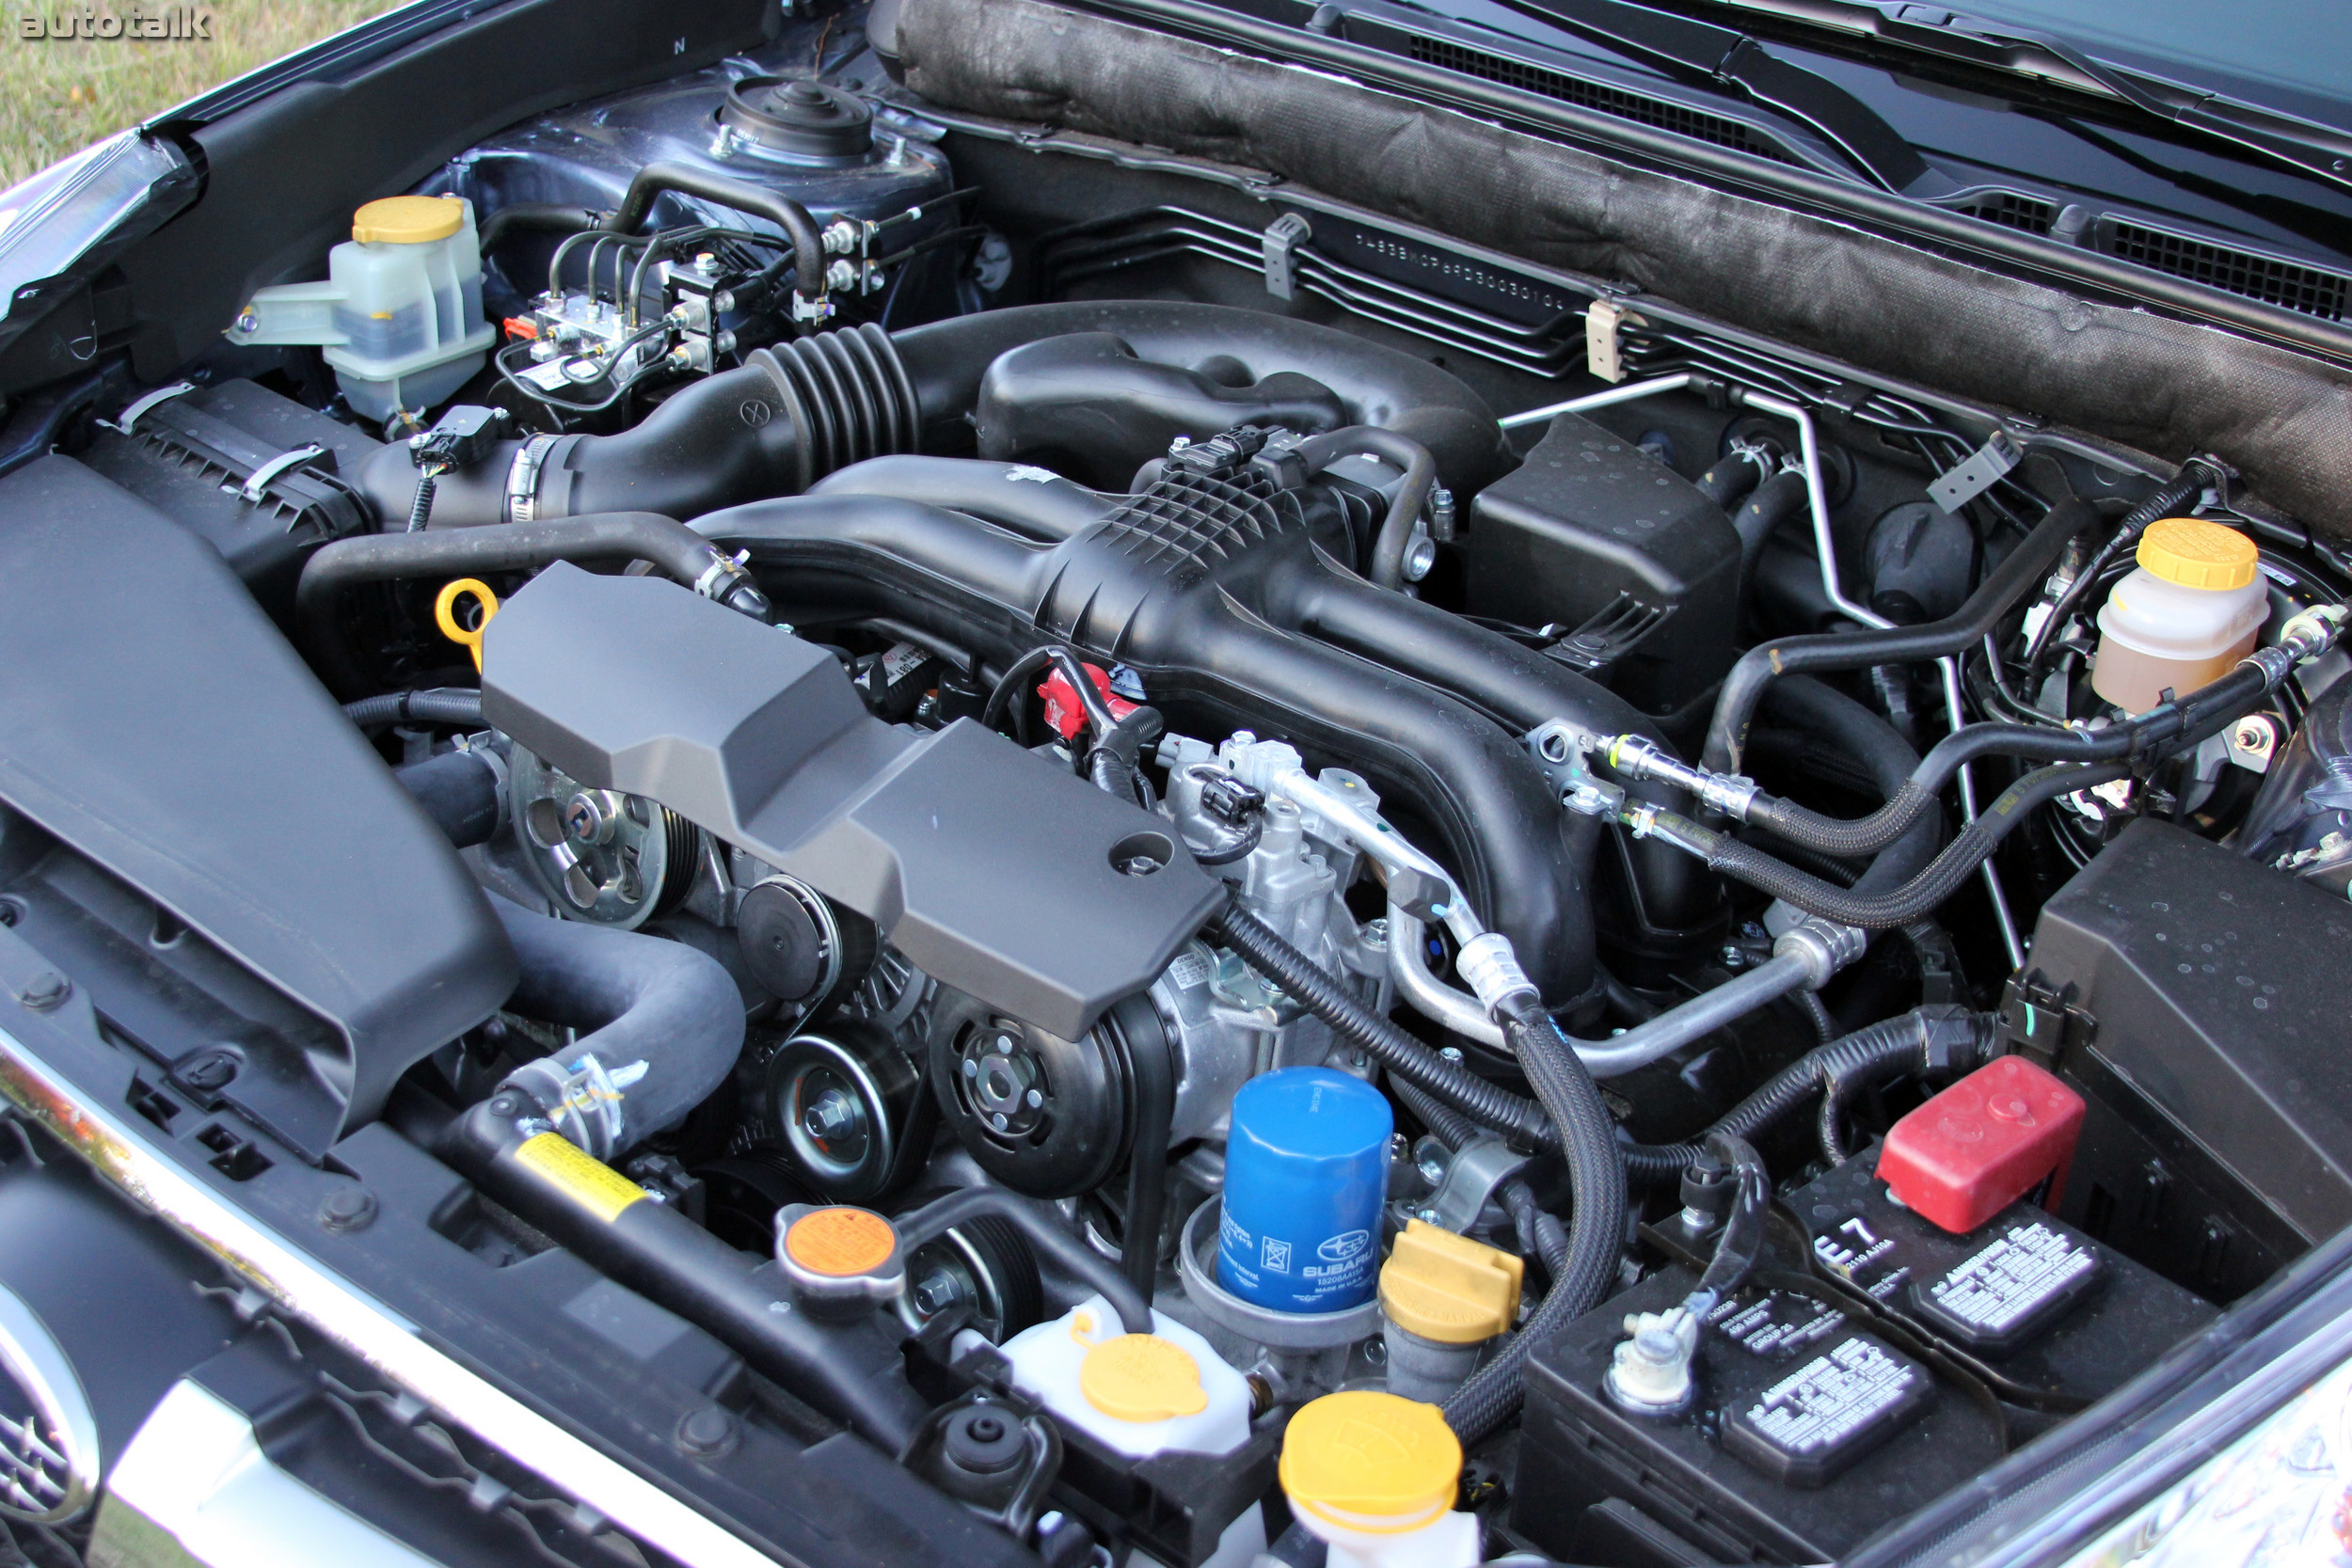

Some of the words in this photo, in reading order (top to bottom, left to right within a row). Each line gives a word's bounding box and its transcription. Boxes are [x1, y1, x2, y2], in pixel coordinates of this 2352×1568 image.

[1303, 1248, 1374, 1277] SUBARU
[1314, 1284, 1337, 1293] MADE
[1728, 1323, 1745, 1336] 490
[1742, 1309, 1770, 1326] AMPS
[1752, 1329, 1783, 1350] GROUP
[1780, 1323, 1795, 1334] 25
